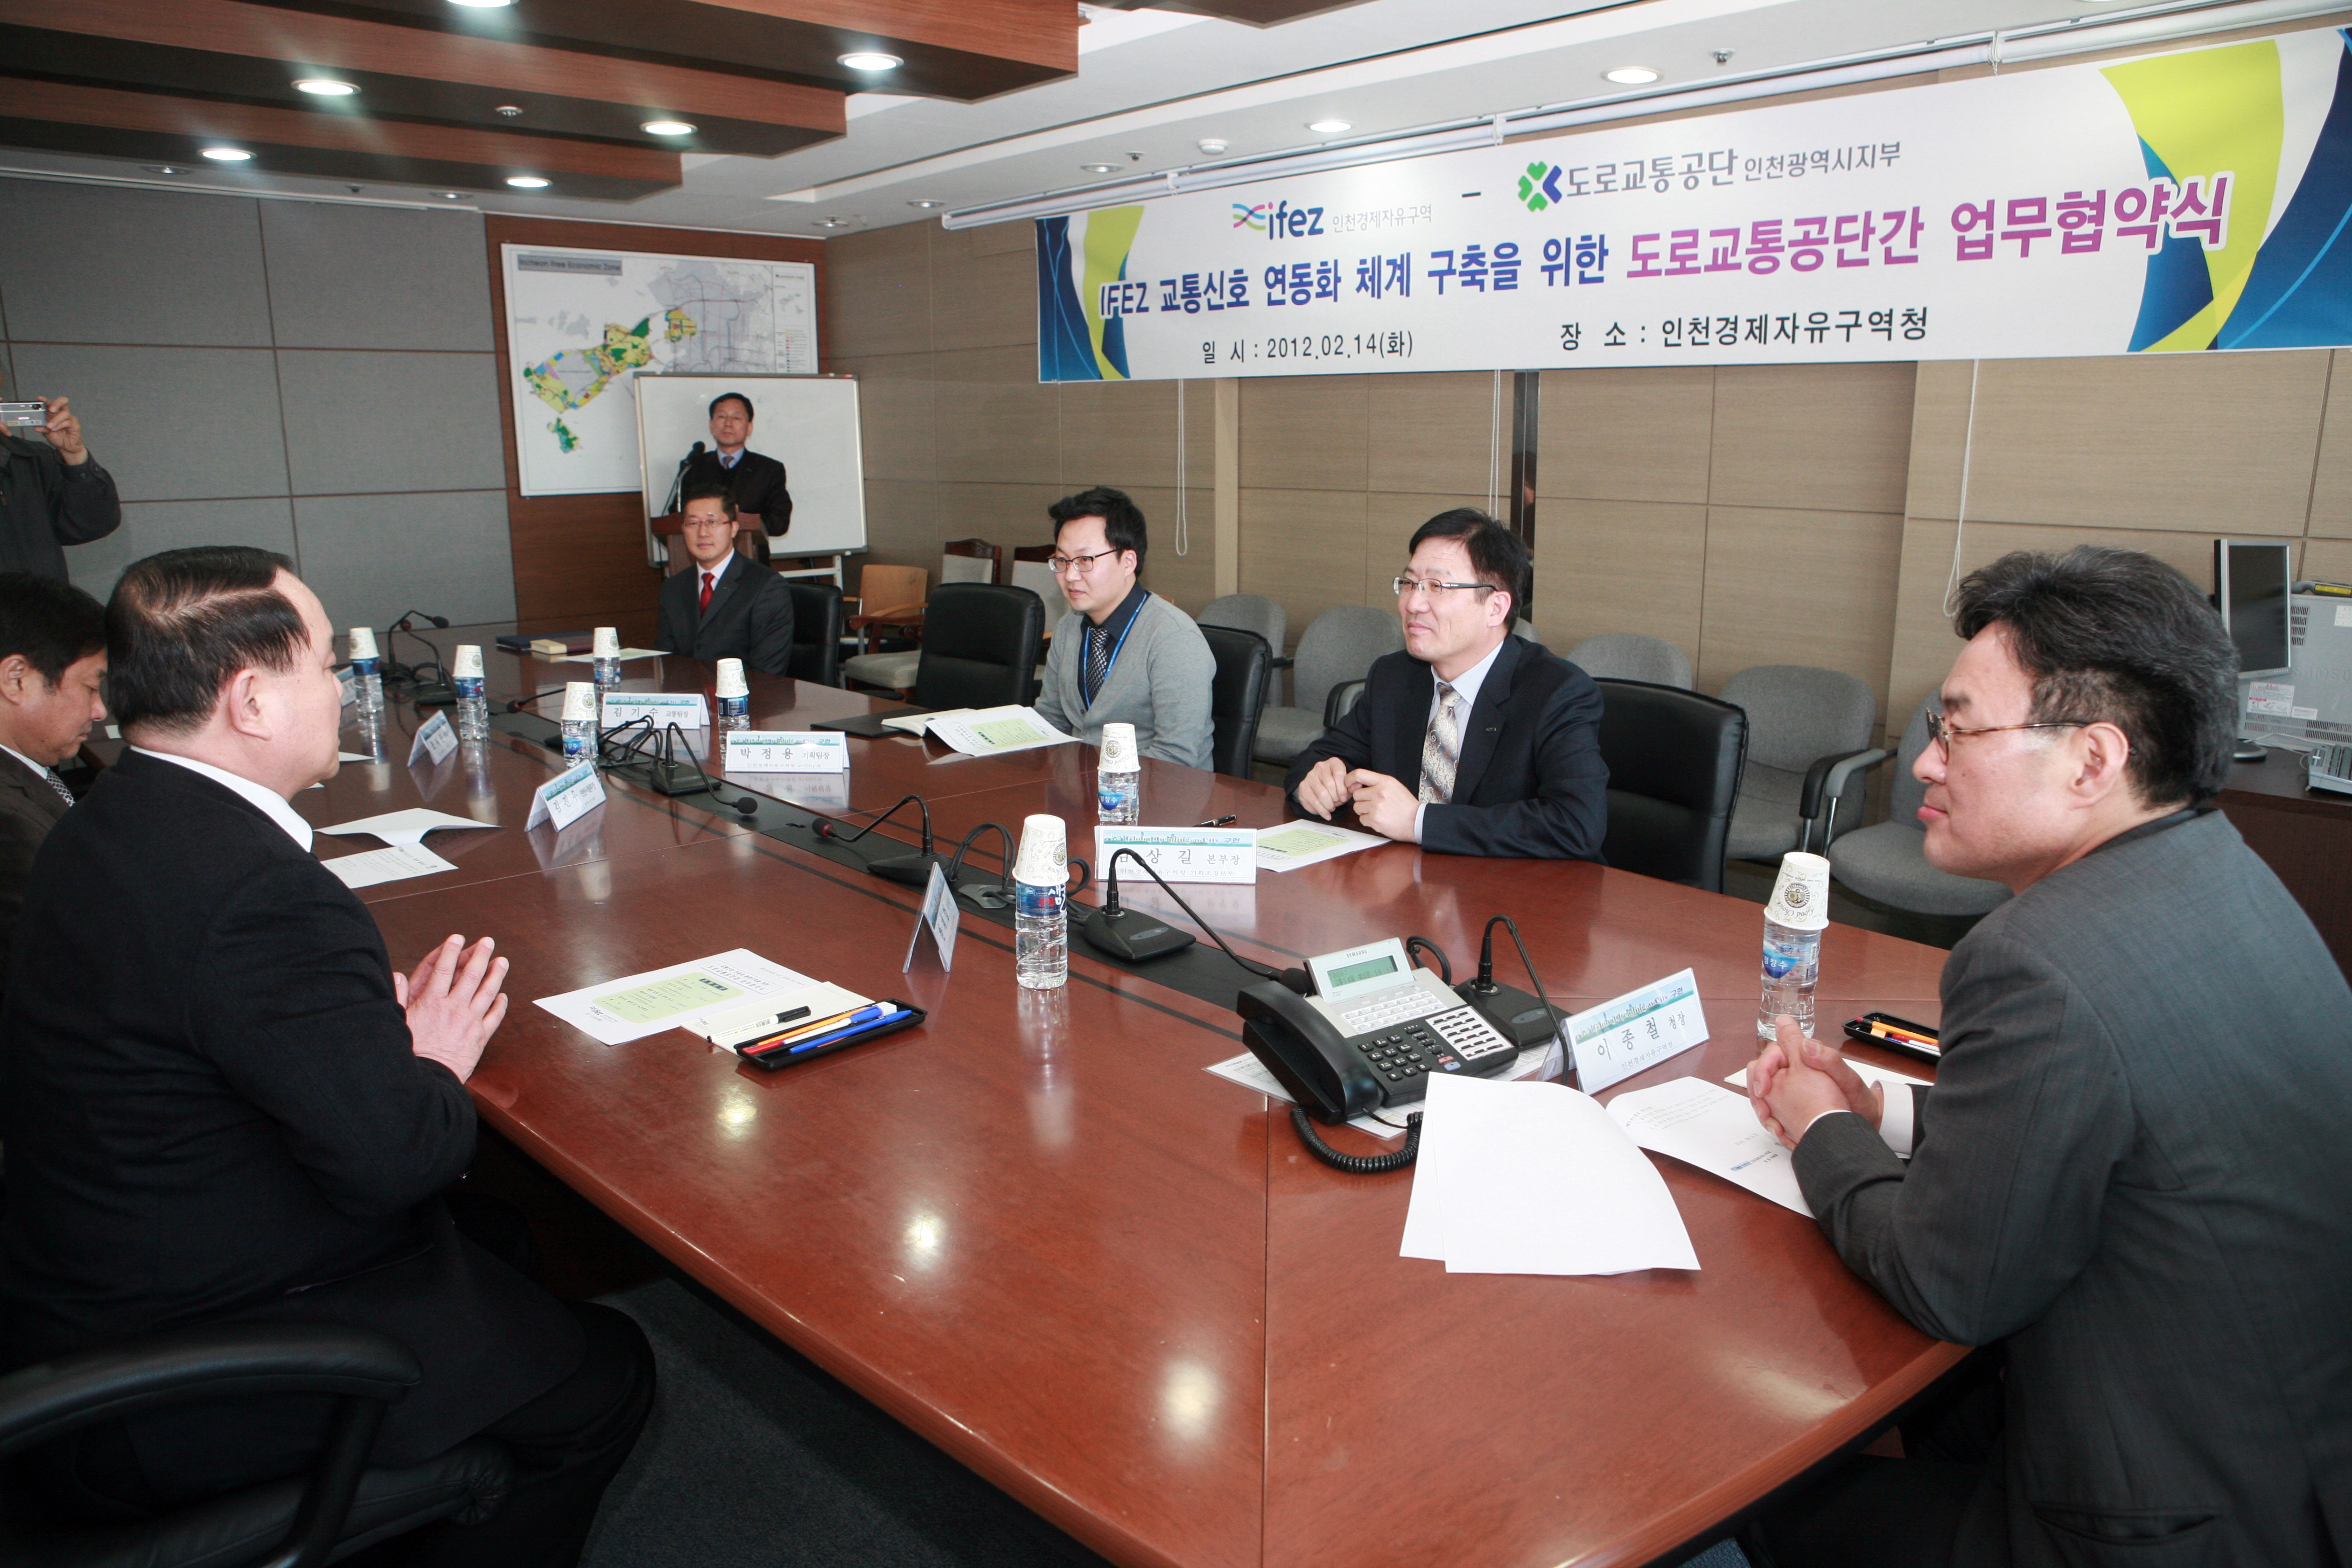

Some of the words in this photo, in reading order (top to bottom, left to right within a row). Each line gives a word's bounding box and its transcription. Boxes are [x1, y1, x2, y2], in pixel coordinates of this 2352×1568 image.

[1566, 148, 1739, 198] 도로교통공단
[1744, 142, 1901, 181] 인천광역시지부
[1268, 200, 1324, 240] ifez
[1332, 204, 1433, 234] 인천경제자유구역
[1101, 282, 1150, 316] IFEZ
[1159, 269, 1250, 314] 교통신호
[1264, 258, 1341, 306] 연동화
[1355, 251, 1411, 299] 체계
[1427, 242, 1522, 296] 구축을
[1540, 234, 1609, 286] 위한
[1627, 206, 1925, 278] 도로교통공단간
[1950, 177, 2228, 262] 업무협약식
[1662, 306, 1928, 347] 인천경제자유구역청
[1266, 330, 1413, 360] 2012.02.14(화)
[1206, 853, 1241, 865] 본부장
[1346, 949, 1368, 958] SAMSUNG
[1668, 1011, 1685, 1030] 청장
[1621, 1040, 1673, 1070] 인천경제자유구역청
